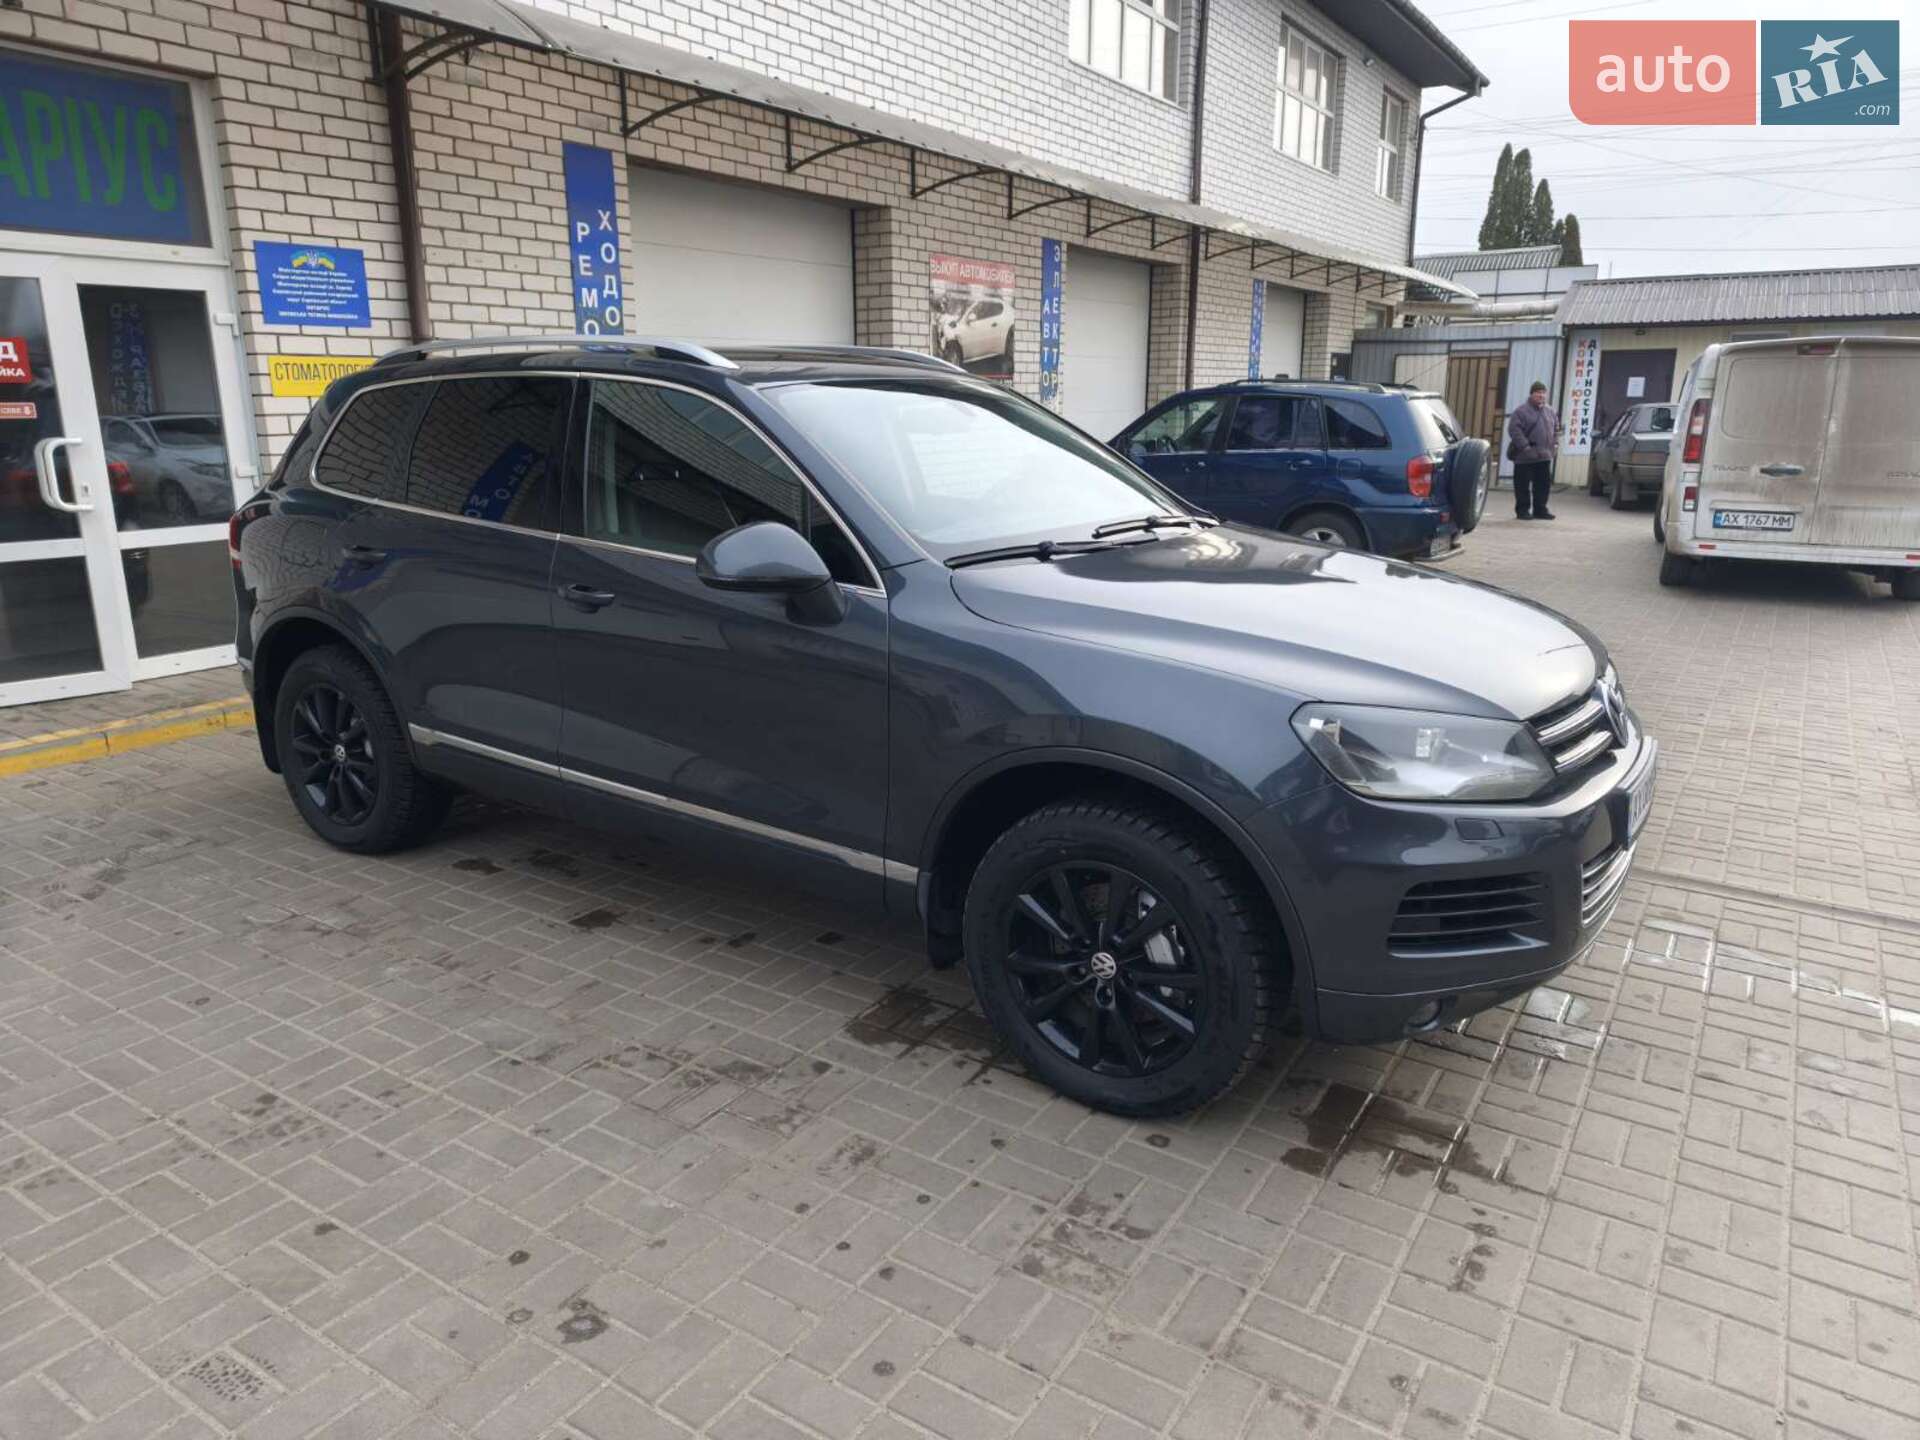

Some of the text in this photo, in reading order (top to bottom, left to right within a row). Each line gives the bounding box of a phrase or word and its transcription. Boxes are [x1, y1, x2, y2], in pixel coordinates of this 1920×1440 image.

[1723, 512, 1742, 524] AX
[1743, 513, 1768, 526] 1767
[1771, 515, 1791, 527] MM
